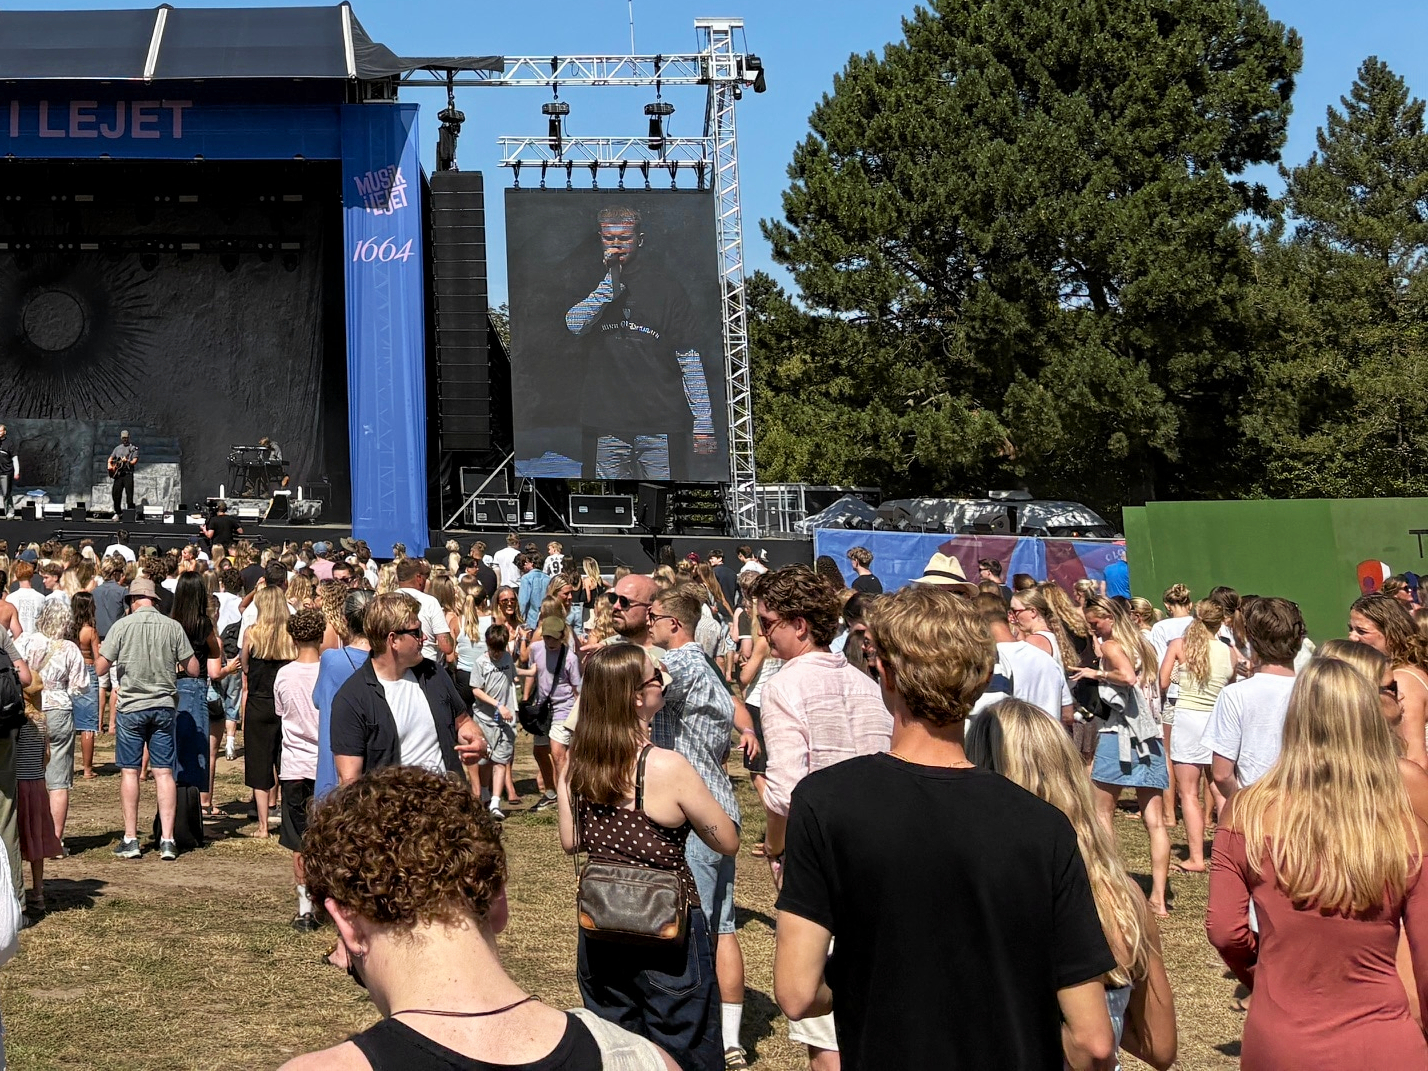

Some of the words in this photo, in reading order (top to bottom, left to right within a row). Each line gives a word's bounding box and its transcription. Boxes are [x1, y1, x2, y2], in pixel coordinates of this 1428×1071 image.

[9, 100, 20, 138] I
[38, 99, 193, 139] LEJET
[368, 184, 408, 216] LEJET
[353, 235, 415, 262] 1664
[552, 560, 560, 575] 9
